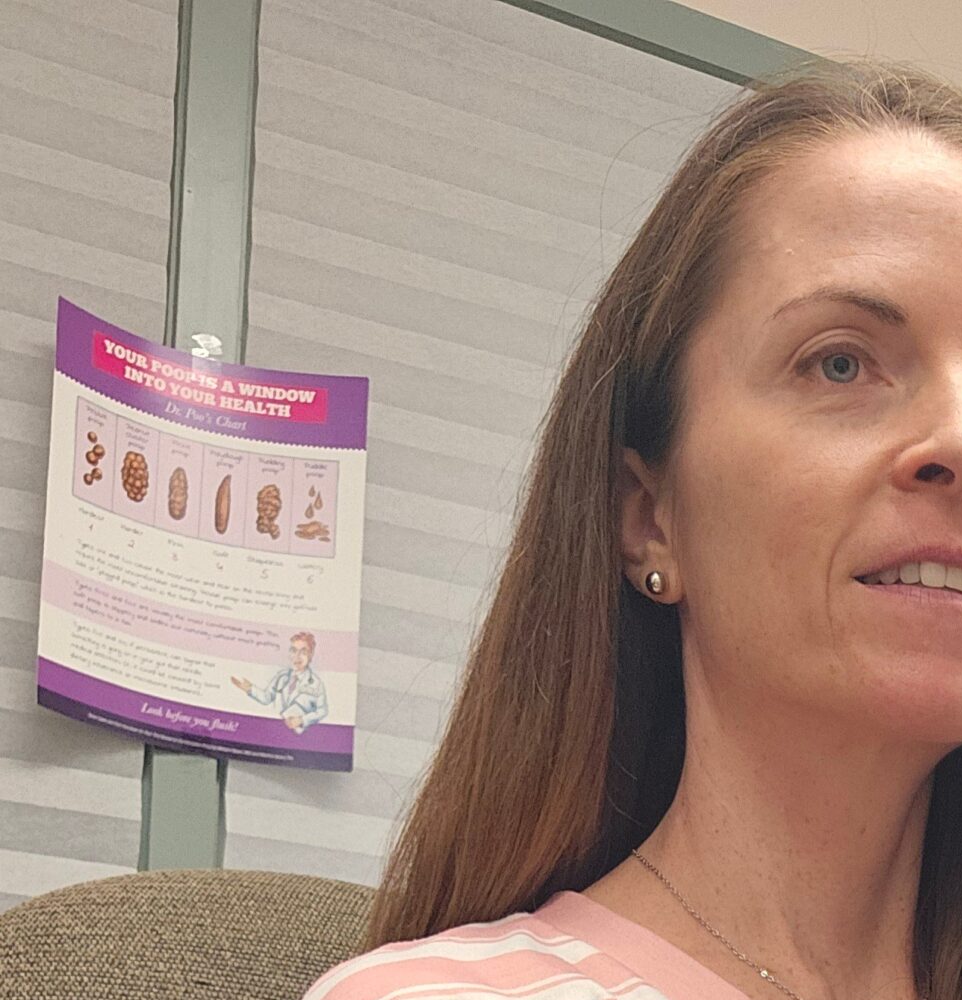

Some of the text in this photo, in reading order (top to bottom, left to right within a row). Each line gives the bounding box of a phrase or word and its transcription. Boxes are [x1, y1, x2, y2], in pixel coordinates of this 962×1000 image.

[104, 340, 149, 369] YOUR
[218, 380, 235, 393] A
[238, 383, 316, 405] WINDOW
[124, 366, 292, 418] INTO YOUR HEALTH
[165, 402, 183, 417] Dr.
[216, 413, 247, 430] Chart
[141, 702, 239, 732] Look before you flush!
